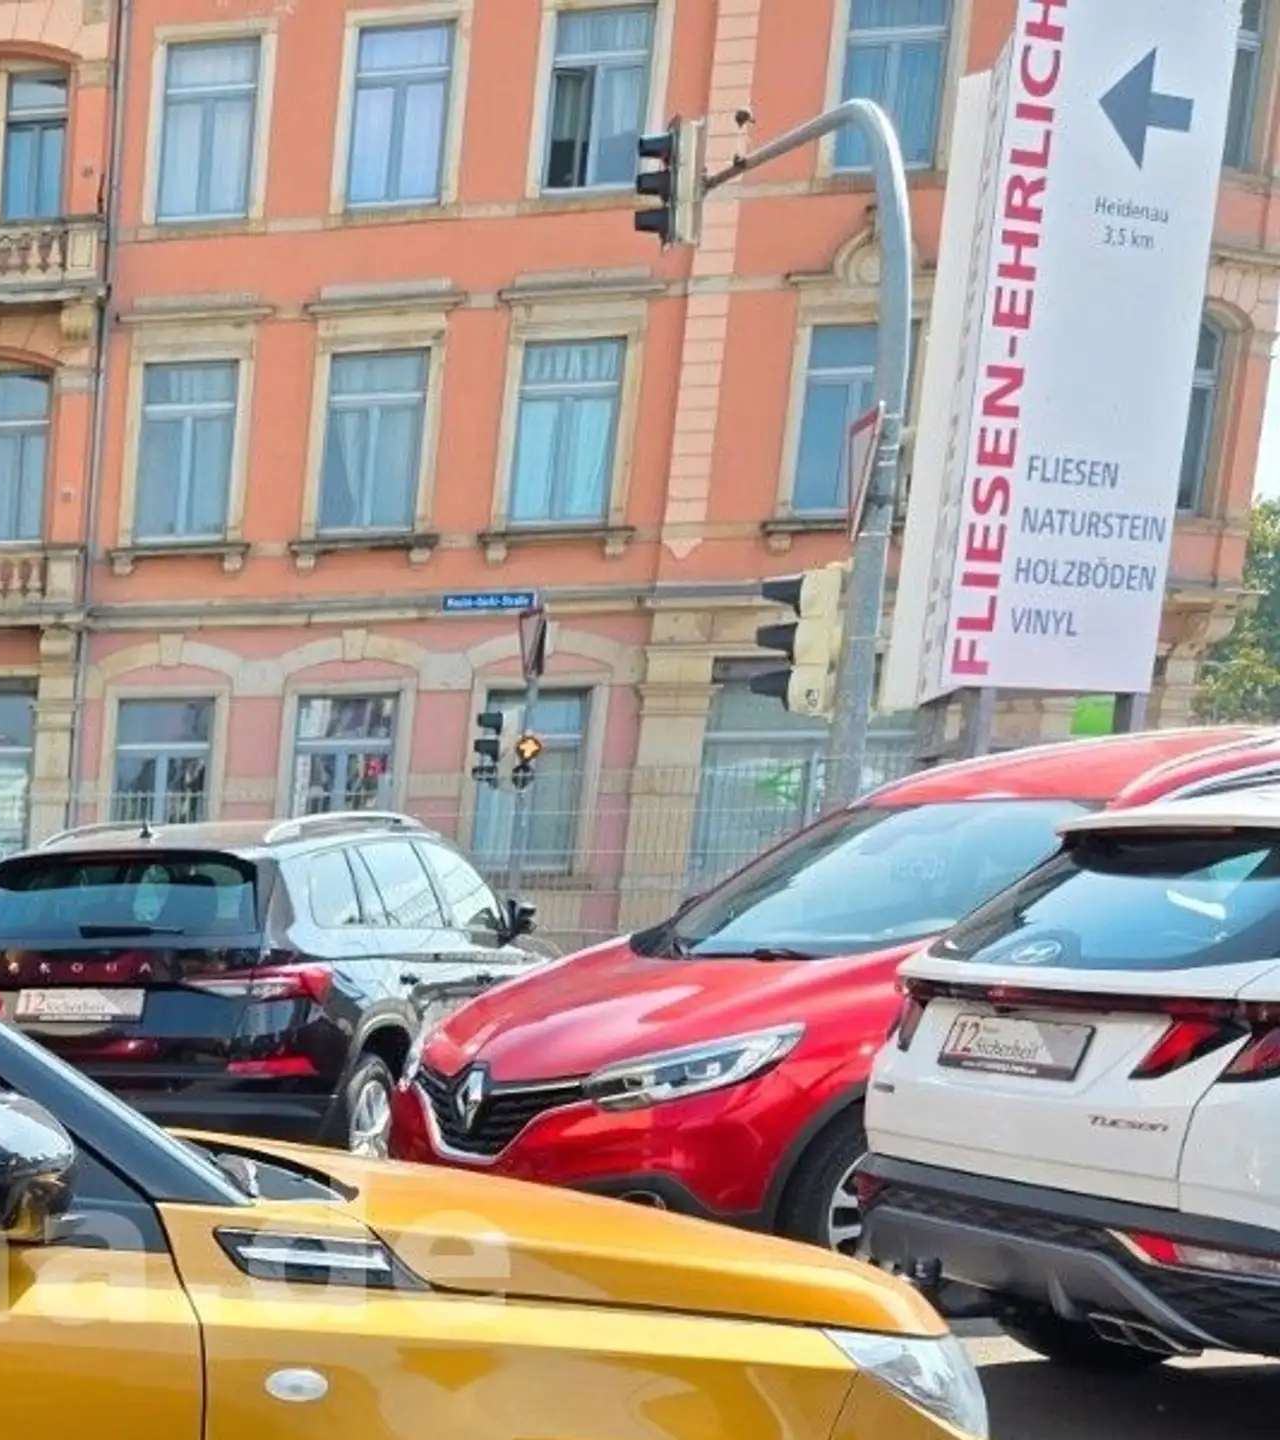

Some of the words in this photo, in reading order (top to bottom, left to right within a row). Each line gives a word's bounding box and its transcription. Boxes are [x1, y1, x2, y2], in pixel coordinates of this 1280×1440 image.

[1093, 195, 1170, 224] Heidenau
[1101, 225, 1127, 247] 3,5
[1130, 229, 1155, 250] km
[1026, 454, 1120, 489] FLIESEN
[1020, 506, 1167, 543] NATURSTEIN
[1014, 556, 1158, 592] HOLZBÖDEN
[1009, 606, 1078, 637] VINYL
[946, 1020, 982, 1055] 12
